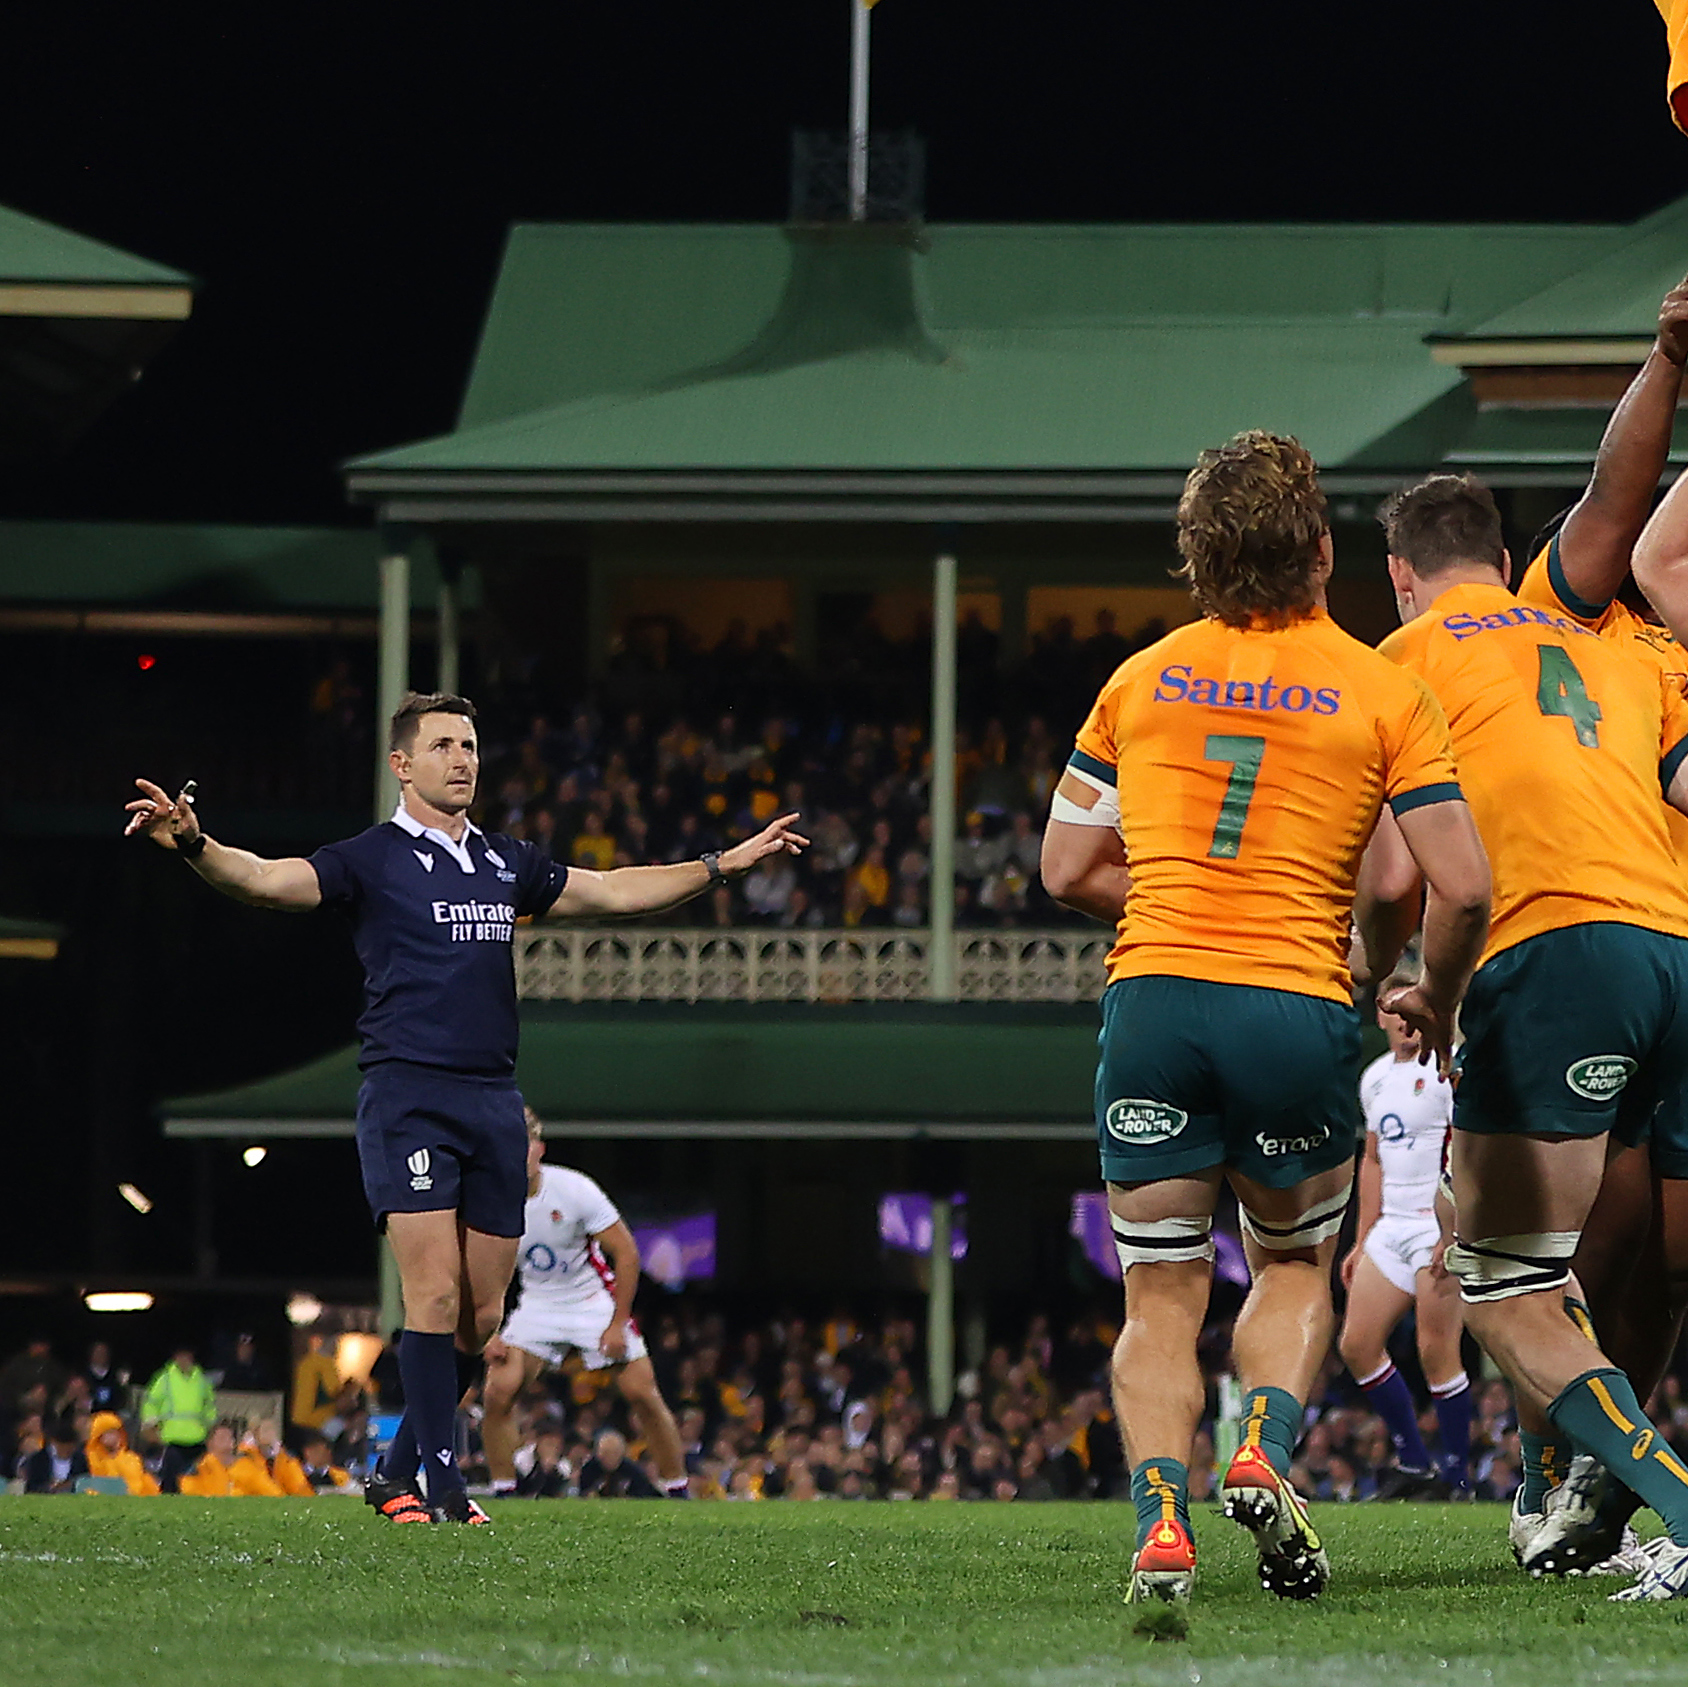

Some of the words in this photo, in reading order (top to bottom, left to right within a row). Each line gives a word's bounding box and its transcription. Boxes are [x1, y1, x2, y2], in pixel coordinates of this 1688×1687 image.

[1154, 665, 1342, 716] Santos
[1536, 643, 1603, 749] 4
[1204, 734, 1266, 860] 7
[451, 923, 473, 942] FLY
